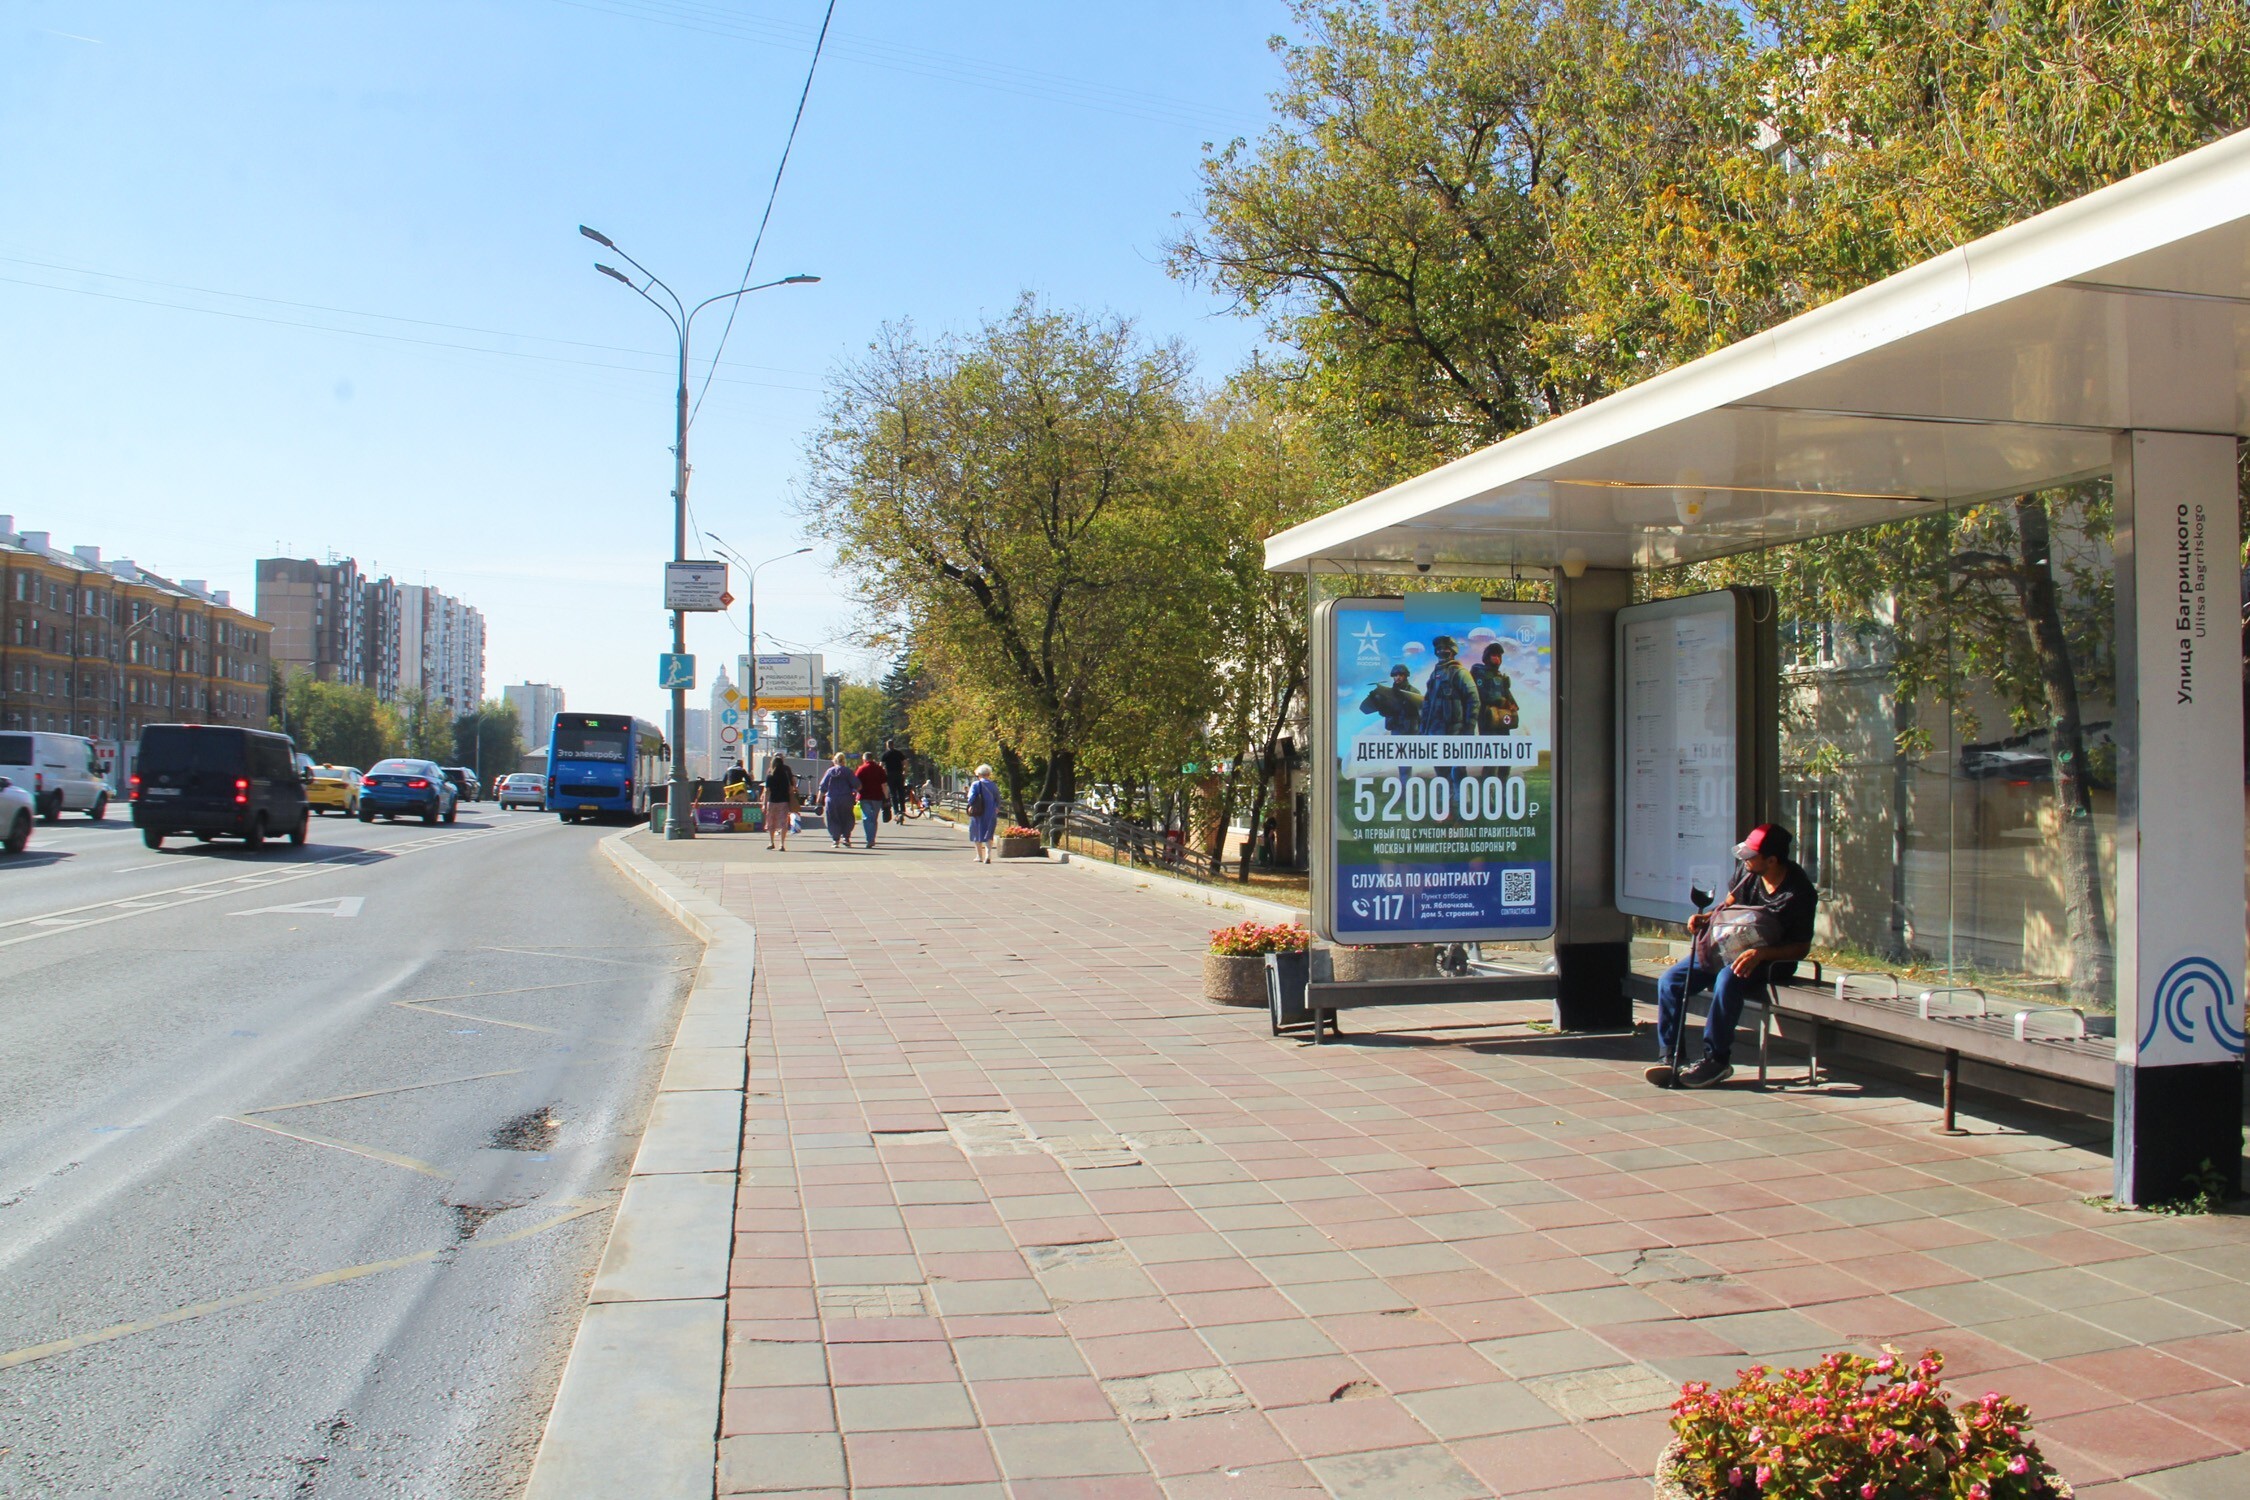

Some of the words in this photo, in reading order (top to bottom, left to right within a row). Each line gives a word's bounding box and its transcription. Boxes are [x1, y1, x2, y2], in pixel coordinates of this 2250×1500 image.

[2194, 504, 2207, 591] Bagritskogo
[2176, 504, 2193, 630] Багрицкого
[2196, 597, 2206, 638] Ulitsa
[1520, 628, 1535, 642] 18+
[2178, 638, 2193, 705] Улица
[576, 751, 625, 760] электробус.
[1357, 742, 1438, 761] ДЕНЕЖНЫЕ
[1443, 742, 1512, 759] ВЫПЛАТЫ
[1517, 742, 1532, 759] ОТ
[1354, 777, 1375, 821] 5
[1382, 776, 1450, 821] 200
[1459, 776, 1526, 821] 000
[1353, 830, 1362, 840] ЗА
[1364, 828, 1394, 839] ПЕРВЫЙ
[1397, 829, 1410, 840] ГОД
[1412, 829, 1417, 839] С
[1419, 828, 1446, 839] УЧЕТОМ
[1449, 827, 1477, 838] ВЫПЛАТ
[1479, 826, 1536, 838] ПРАВИТЕЛЬСТВА
[1373, 843, 1404, 854] МОСКВЫ
[1407, 843, 1412, 853] И
[1414, 842, 1468, 853] МИНИСТЕРСТВА
[1471, 842, 1504, 852] ОБОРОНЫ
[1506, 841, 1517, 852] РФ
[1352, 872, 1402, 888] СЛУЖБА
[1406, 873, 1421, 887] ПО
[1424, 871, 1490, 887] КОНТРАКТУ
[1373, 894, 1404, 921] 117
